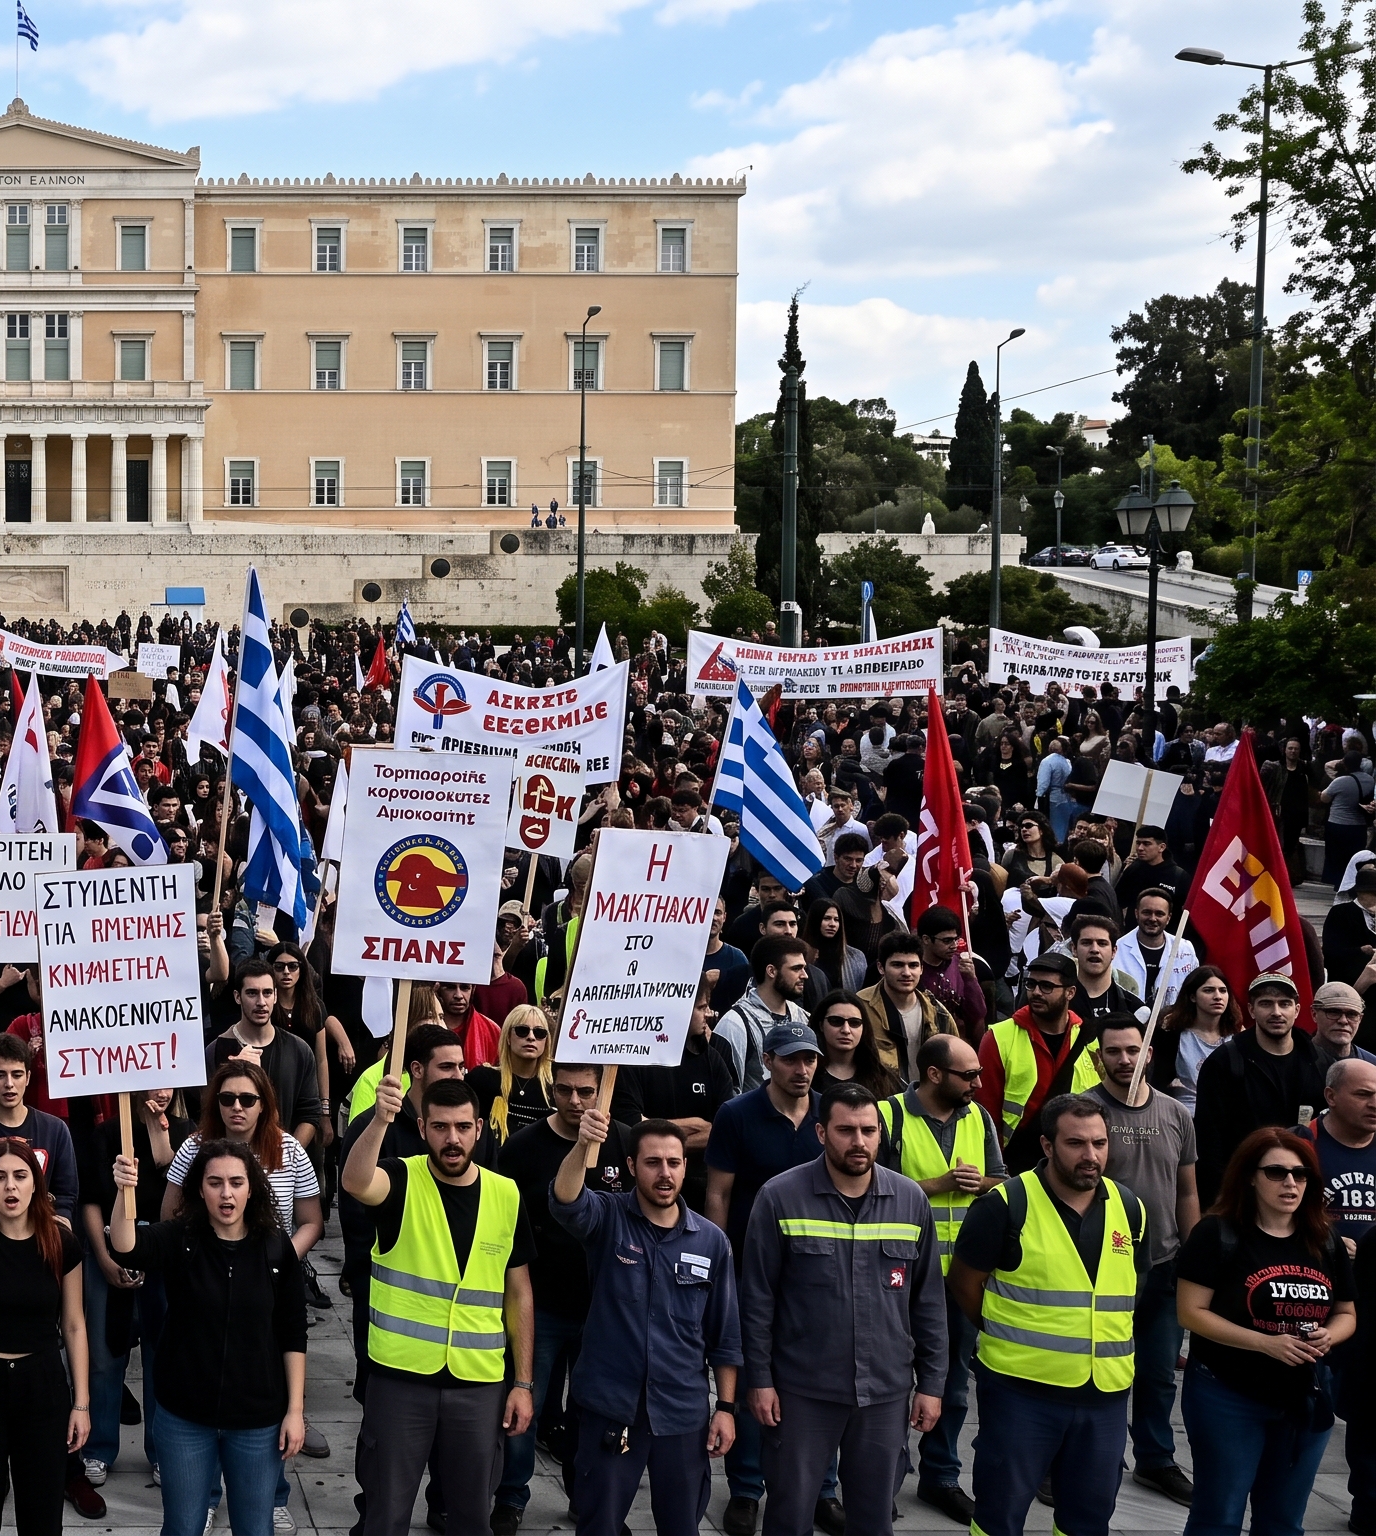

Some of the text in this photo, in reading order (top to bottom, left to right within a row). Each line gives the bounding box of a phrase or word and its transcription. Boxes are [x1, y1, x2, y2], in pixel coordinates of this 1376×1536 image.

[646, 844, 673, 882] Η
[44, 922, 76, 946] ΓΙΑ
[361, 936, 466, 966] ΣΠΑΝΣ
